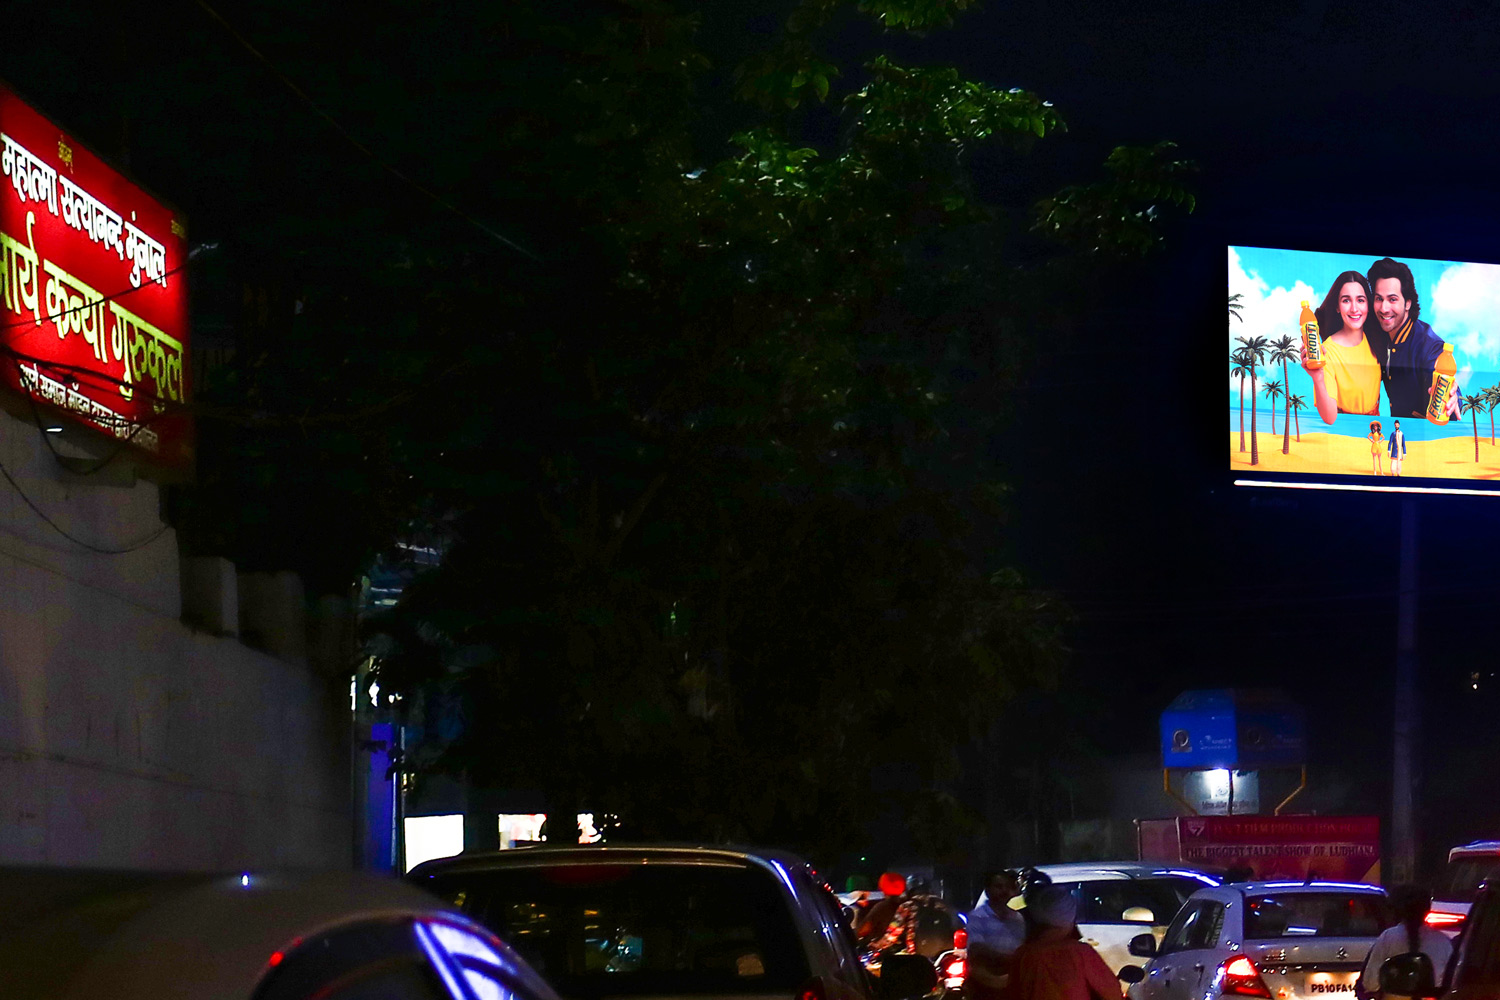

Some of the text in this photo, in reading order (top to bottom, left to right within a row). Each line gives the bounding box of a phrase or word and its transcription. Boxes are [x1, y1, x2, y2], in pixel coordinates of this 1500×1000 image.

[1, 132, 59, 216] महात्मा
[59, 174, 124, 261] सत्यानन्द
[43, 258, 108, 364] कन्या
[1308, 323, 1317, 360] FROOTI
[1428, 376, 1449, 418] FROOTI
[1185, 847, 1204, 858] THE
[1206, 846, 1244, 858] BIGGEST
[1247, 846, 1281, 857] TALENT
[1284, 846, 1311, 857] SHOW
[1314, 846, 1325, 857] OF
